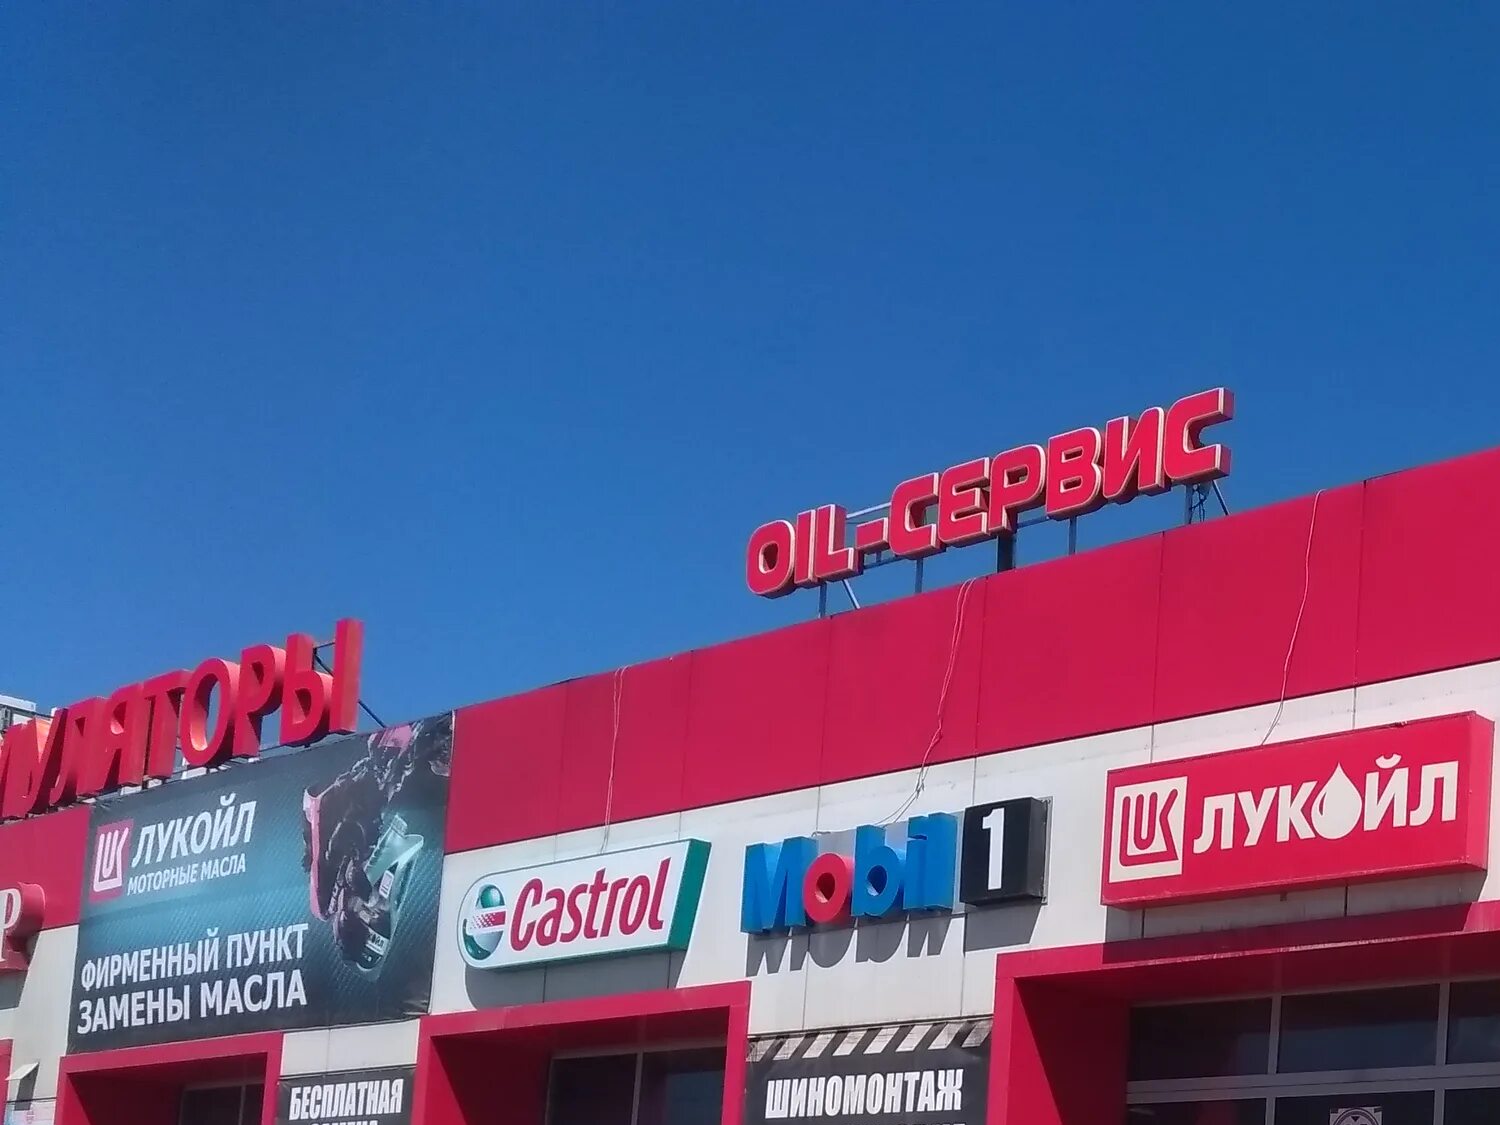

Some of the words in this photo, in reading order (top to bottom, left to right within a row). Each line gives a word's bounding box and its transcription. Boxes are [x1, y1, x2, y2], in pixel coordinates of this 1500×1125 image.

[746, 387, 1234, 598] OIL-СЕРВИС
[131, 793, 256, 867] ЛУКОЙЛ
[1193, 753, 1459, 855] ЛУКОЙЛ
[127, 864, 198, 896] МОТОРНЫЕ
[200, 853, 246, 884] МАСЛА
[509, 856, 670, 952] Castrol
[740, 812, 957, 932] Mobil
[982, 807, 1005, 891] 1
[81, 928, 219, 992] ФИРМЕННЫЙ
[226, 923, 308, 969] ПУНКТ
[76, 986, 191, 1035] ЗАМЕНЫ
[200, 969, 308, 1018] МАСЛА
[288, 1078, 403, 1121] БЕСПЛАТНАЯ
[764, 1069, 963, 1120] ШИНОМОНТАЖ
